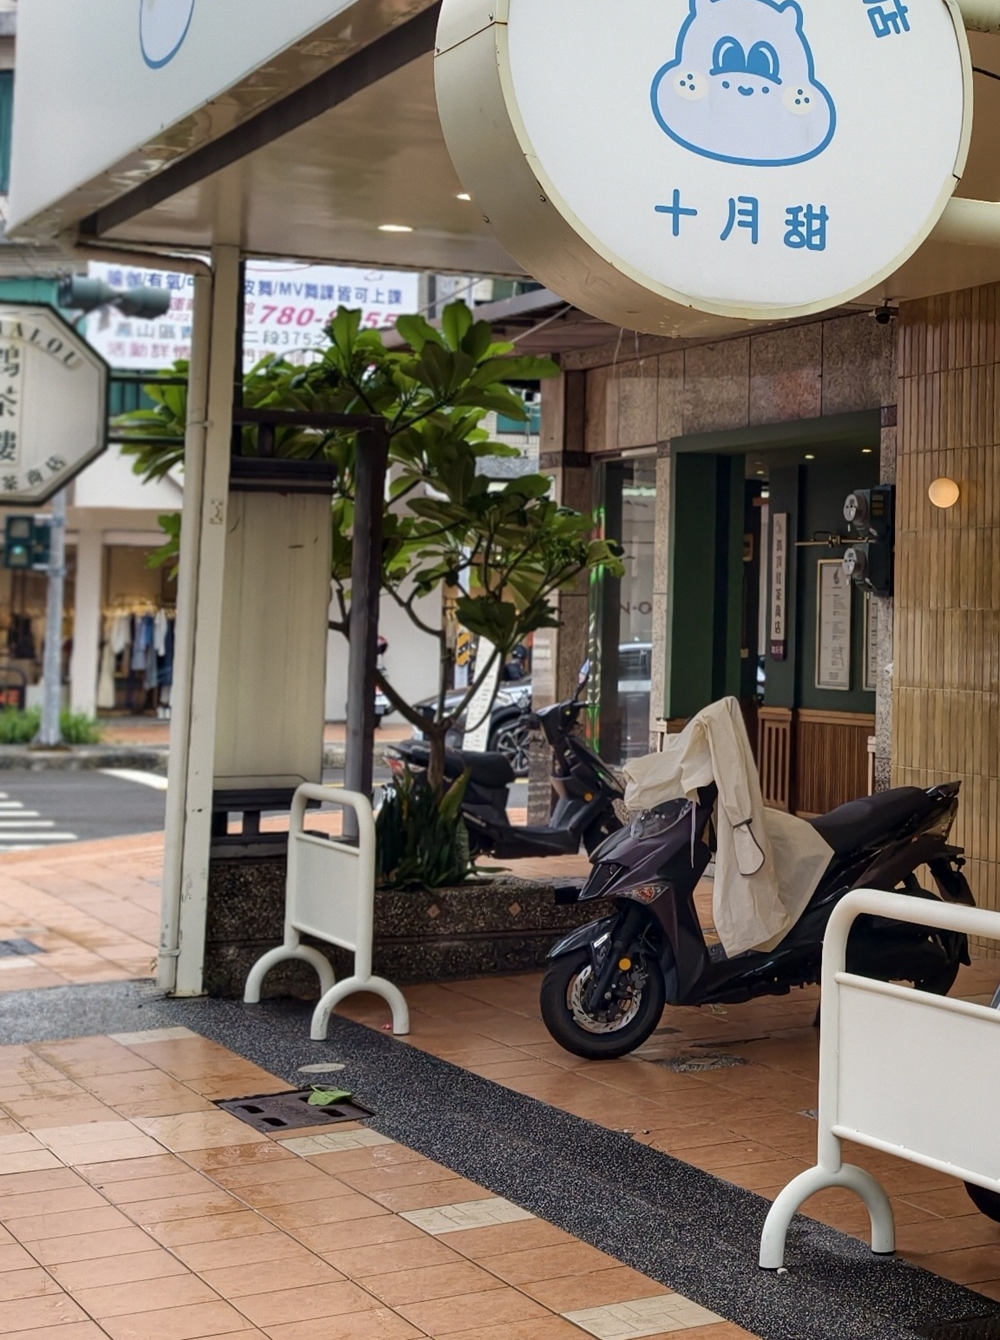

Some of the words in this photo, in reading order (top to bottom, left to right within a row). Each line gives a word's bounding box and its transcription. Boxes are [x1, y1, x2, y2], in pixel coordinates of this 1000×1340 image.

[654, 188, 829, 252] 十月甜
[258, 305, 400, 328] 780-55
[0, 319, 83, 369] ALOU
